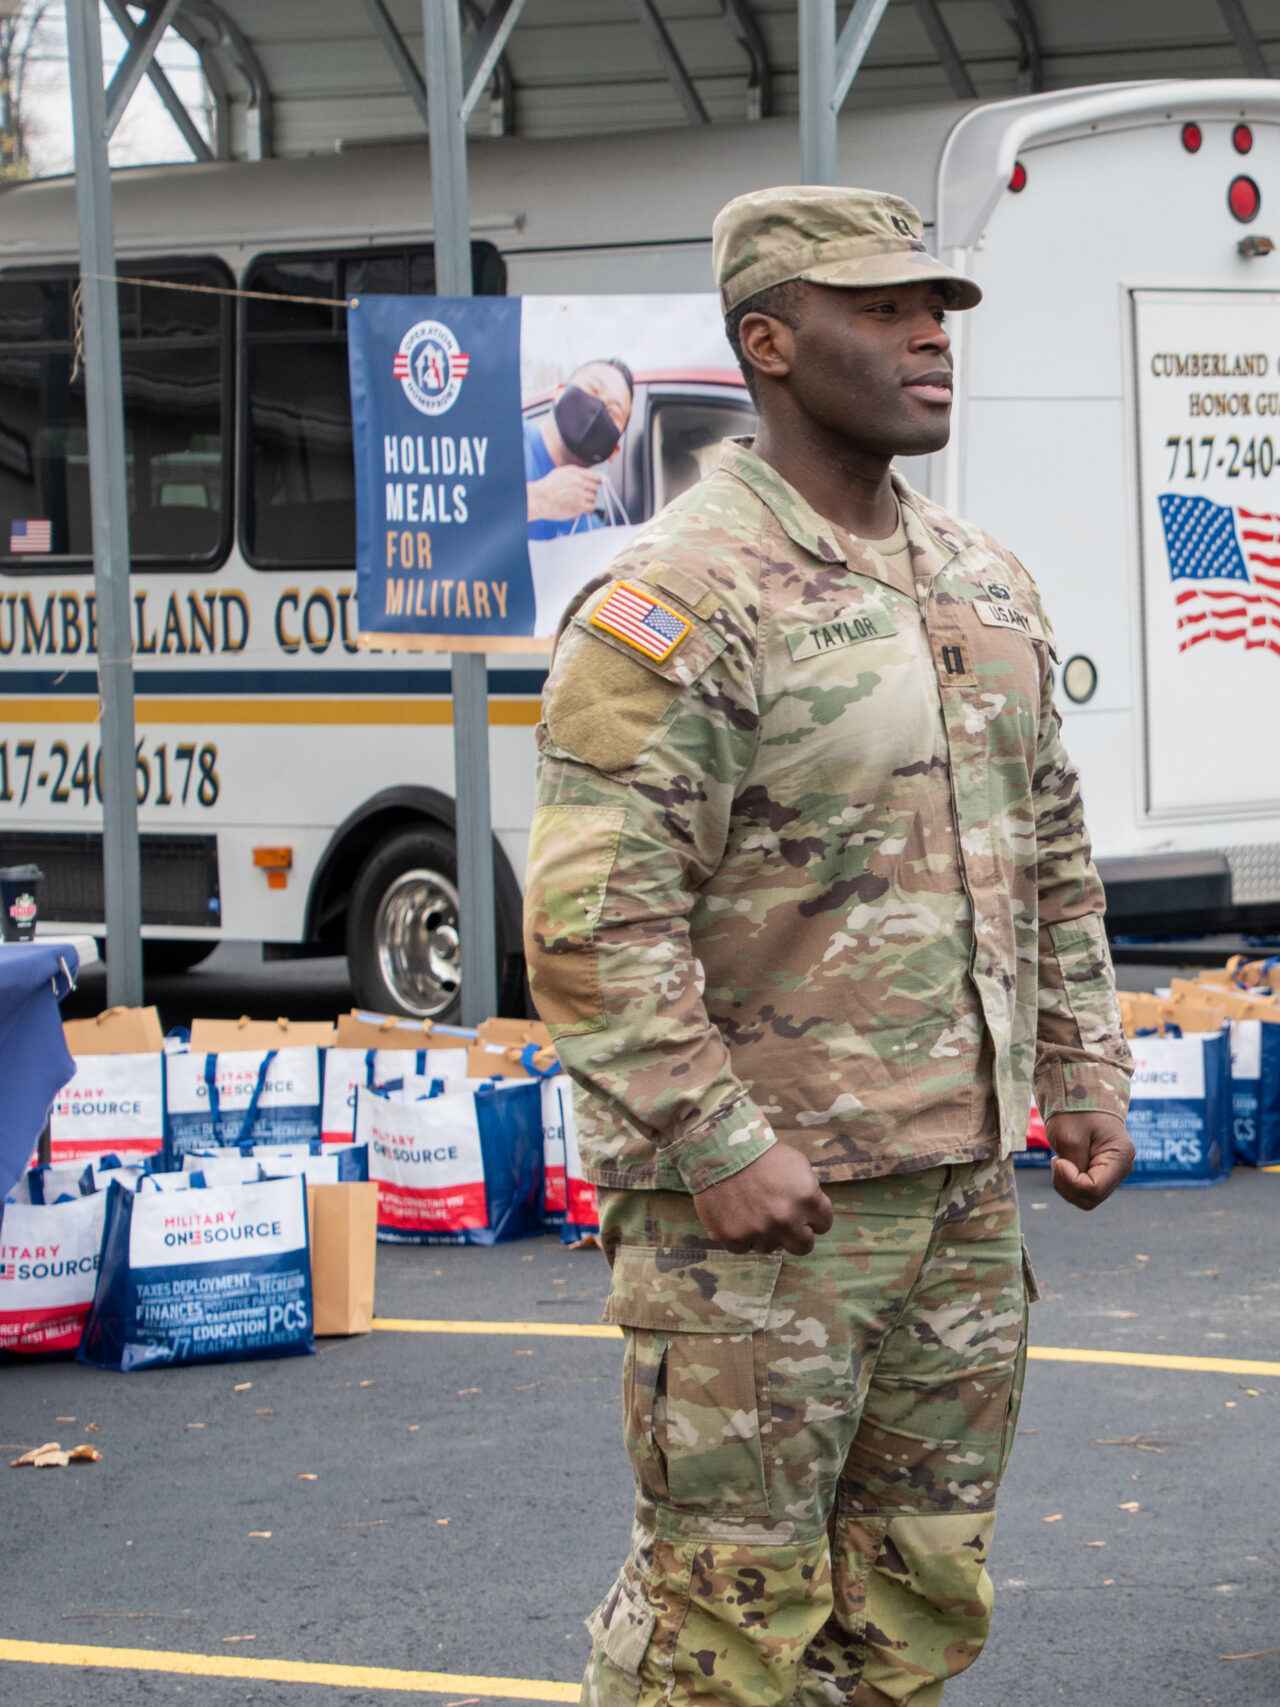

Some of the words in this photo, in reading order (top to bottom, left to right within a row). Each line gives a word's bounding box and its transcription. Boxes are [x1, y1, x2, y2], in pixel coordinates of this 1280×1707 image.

[1152, 353, 1268, 377] CUMBERLAND
[1189, 394, 1251, 416] HONOR
[384, 434, 488, 476] HOLIDAY
[385, 483, 469, 523] MEALS
[386, 531, 432, 569] FOR
[385, 578, 508, 618] MILITARY
[809, 615, 877, 649] TAYLOR
[1233, 1118, 1256, 1141] CS
[1164, 1139, 1202, 1164] PCS
[164, 1210, 237, 1228] MILITARY
[2, 1244, 60, 1259] ITARY
[136, 1283, 170, 1297] TAXES
[173, 1273, 252, 1295] DEPLOYMENT
[259, 1274, 305, 1294] RECREATION
[136, 1301, 204, 1321] FINANCES
[206, 1307, 267, 1324] CAREGIVING
[269, 1300, 307, 1333] PCS
[193, 1319, 267, 1340] EDUCATION
